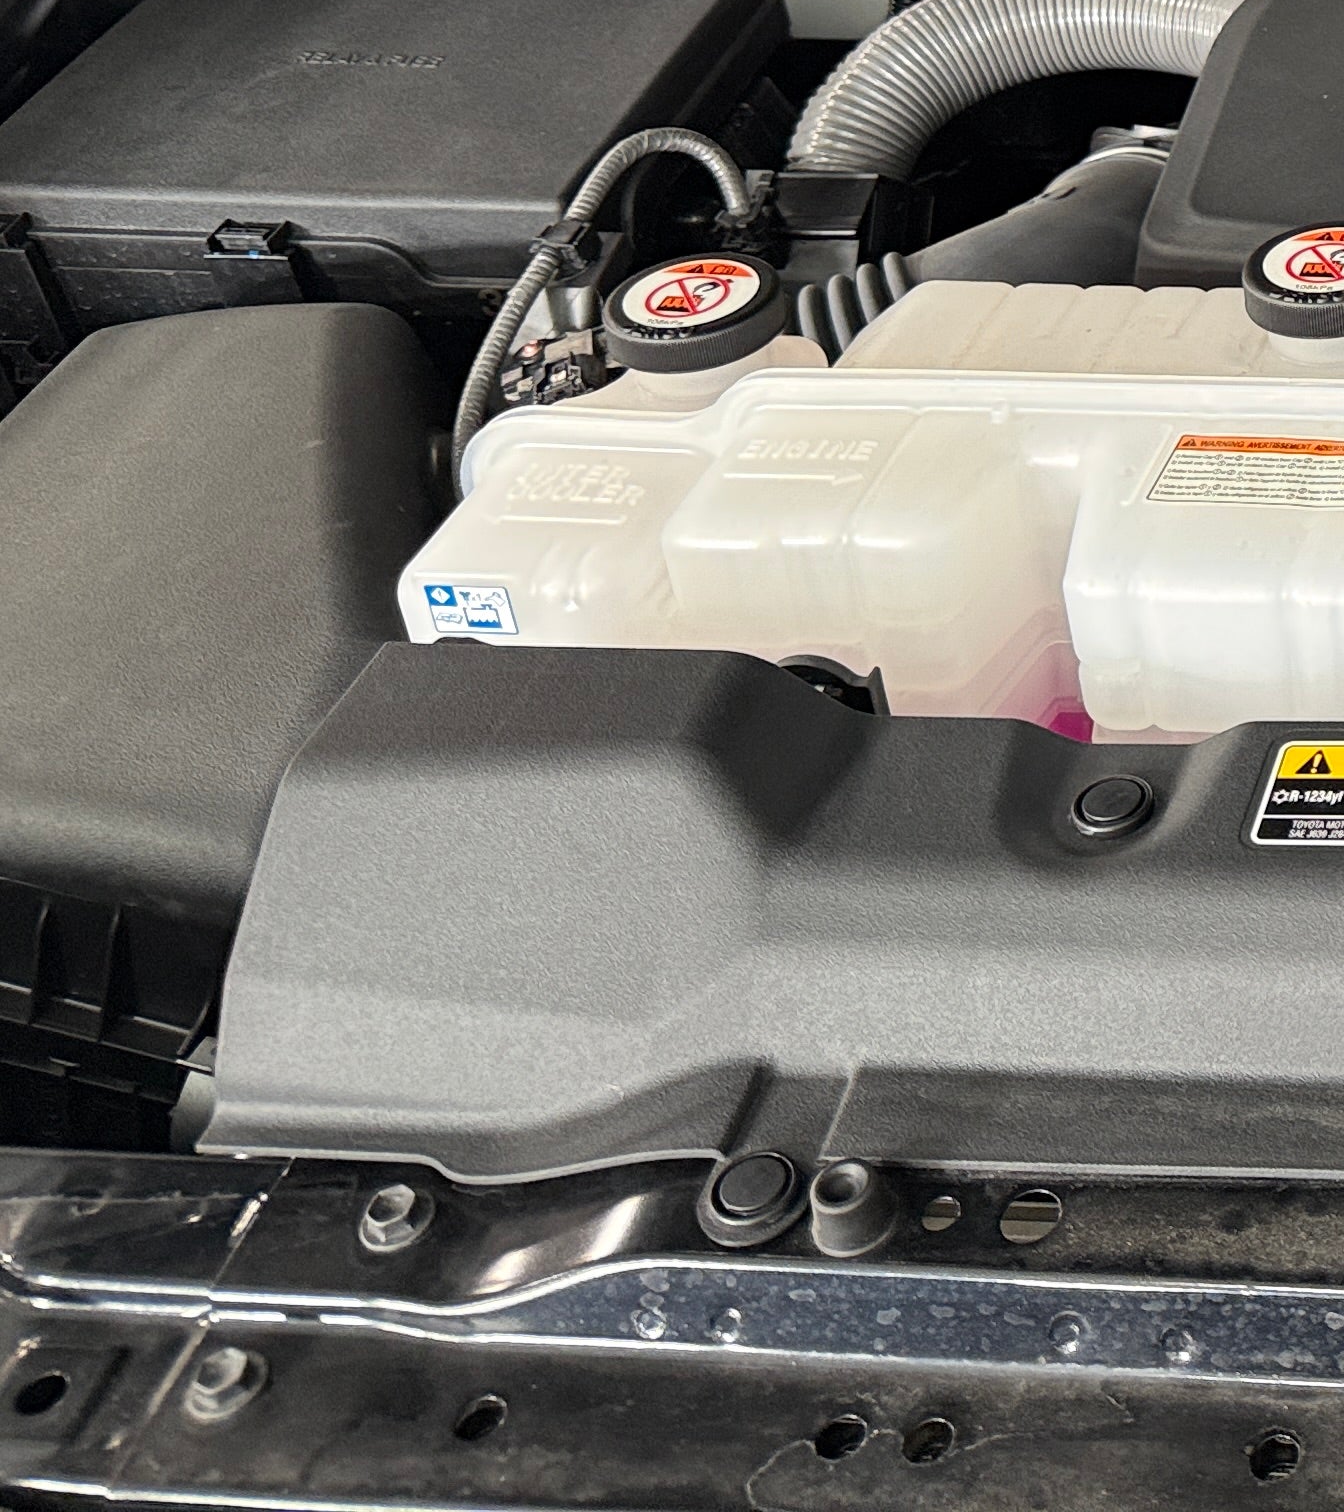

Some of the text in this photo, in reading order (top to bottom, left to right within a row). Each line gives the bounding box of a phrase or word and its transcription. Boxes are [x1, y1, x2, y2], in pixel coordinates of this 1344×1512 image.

[737, 438, 879, 462] ENGINE
[1200, 439, 1244, 448] WARNING
[505, 479, 646, 506] COOLER
[1289, 789, 1343, 805] R-1234yf
[1291, 820, 1325, 830] TOYOTA
[1288, 829, 1305, 838] SAE
